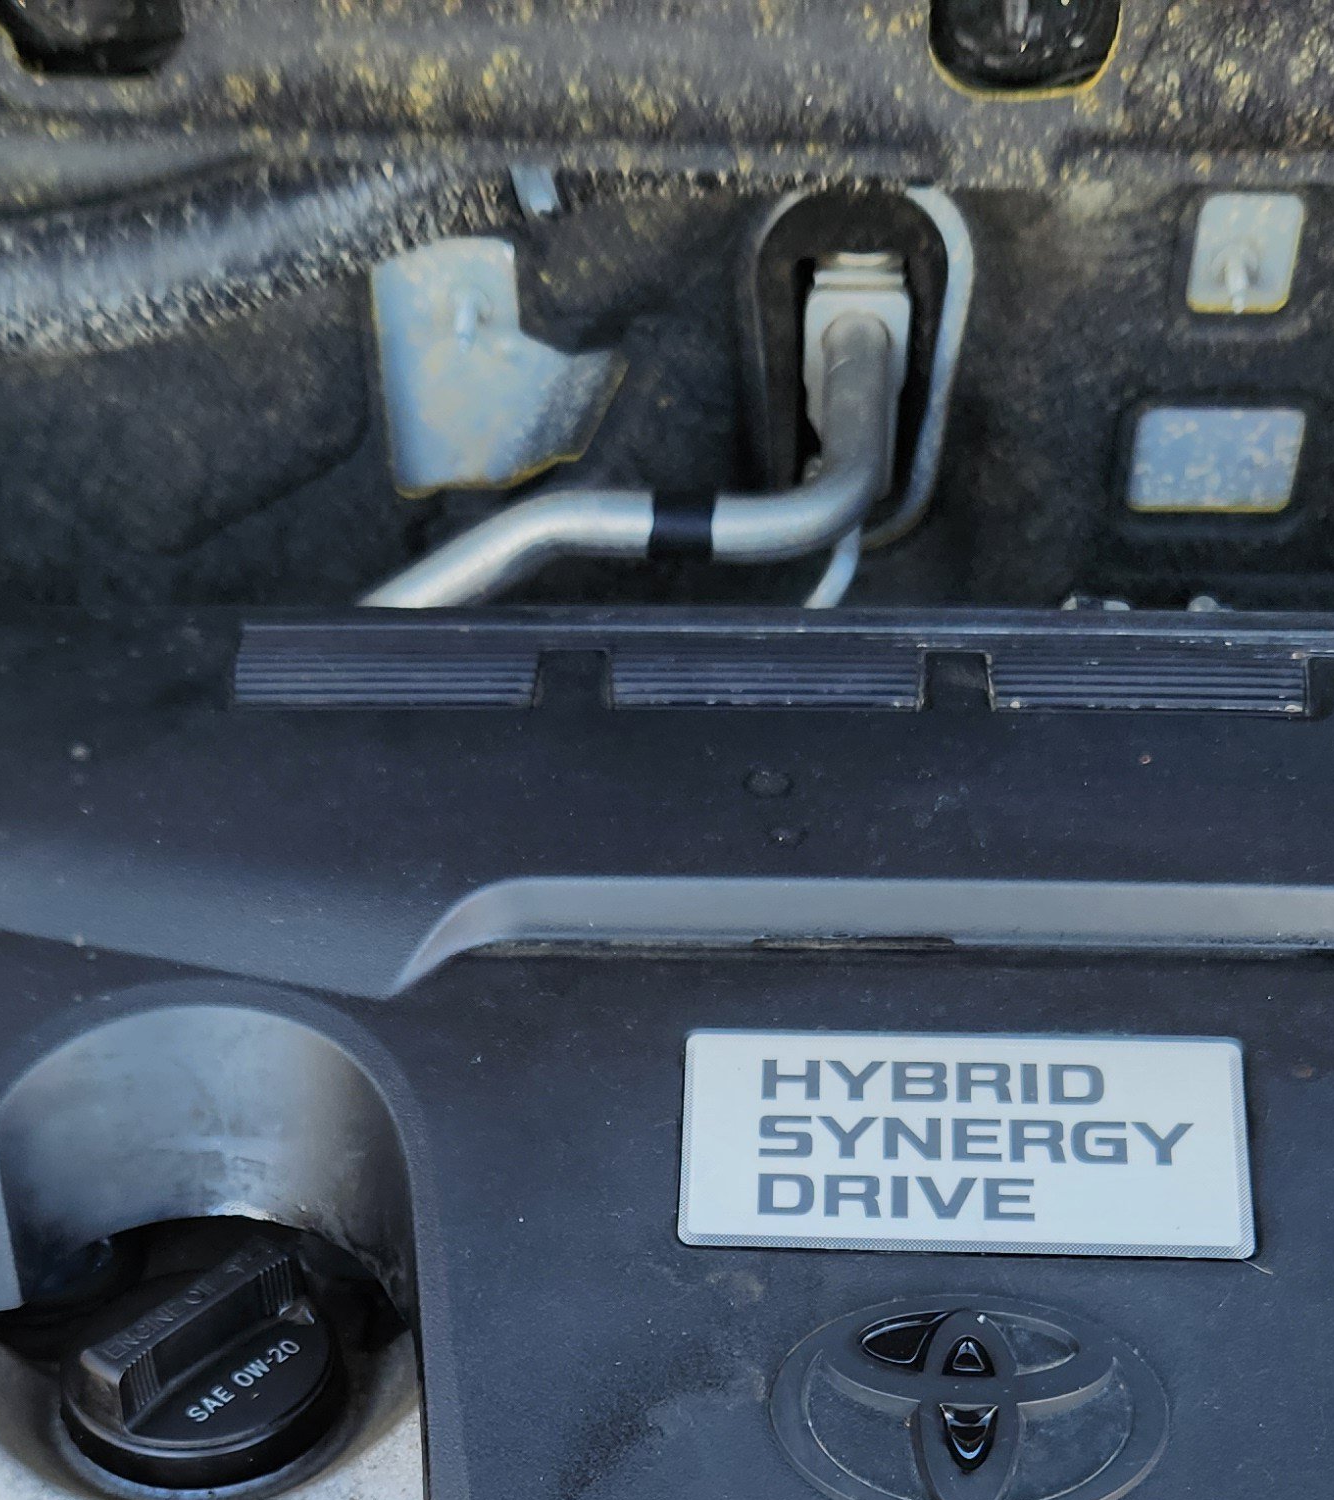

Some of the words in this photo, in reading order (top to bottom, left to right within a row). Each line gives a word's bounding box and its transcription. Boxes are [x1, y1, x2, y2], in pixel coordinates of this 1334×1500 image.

[760, 1058, 1105, 1106] HYBRID
[758, 1114, 1194, 1166] SYNERGY
[756, 1172, 1036, 1222] DRIVE
[185, 1385, 236, 1424] SAE
[232, 1339, 301, 1389] 0W-20
